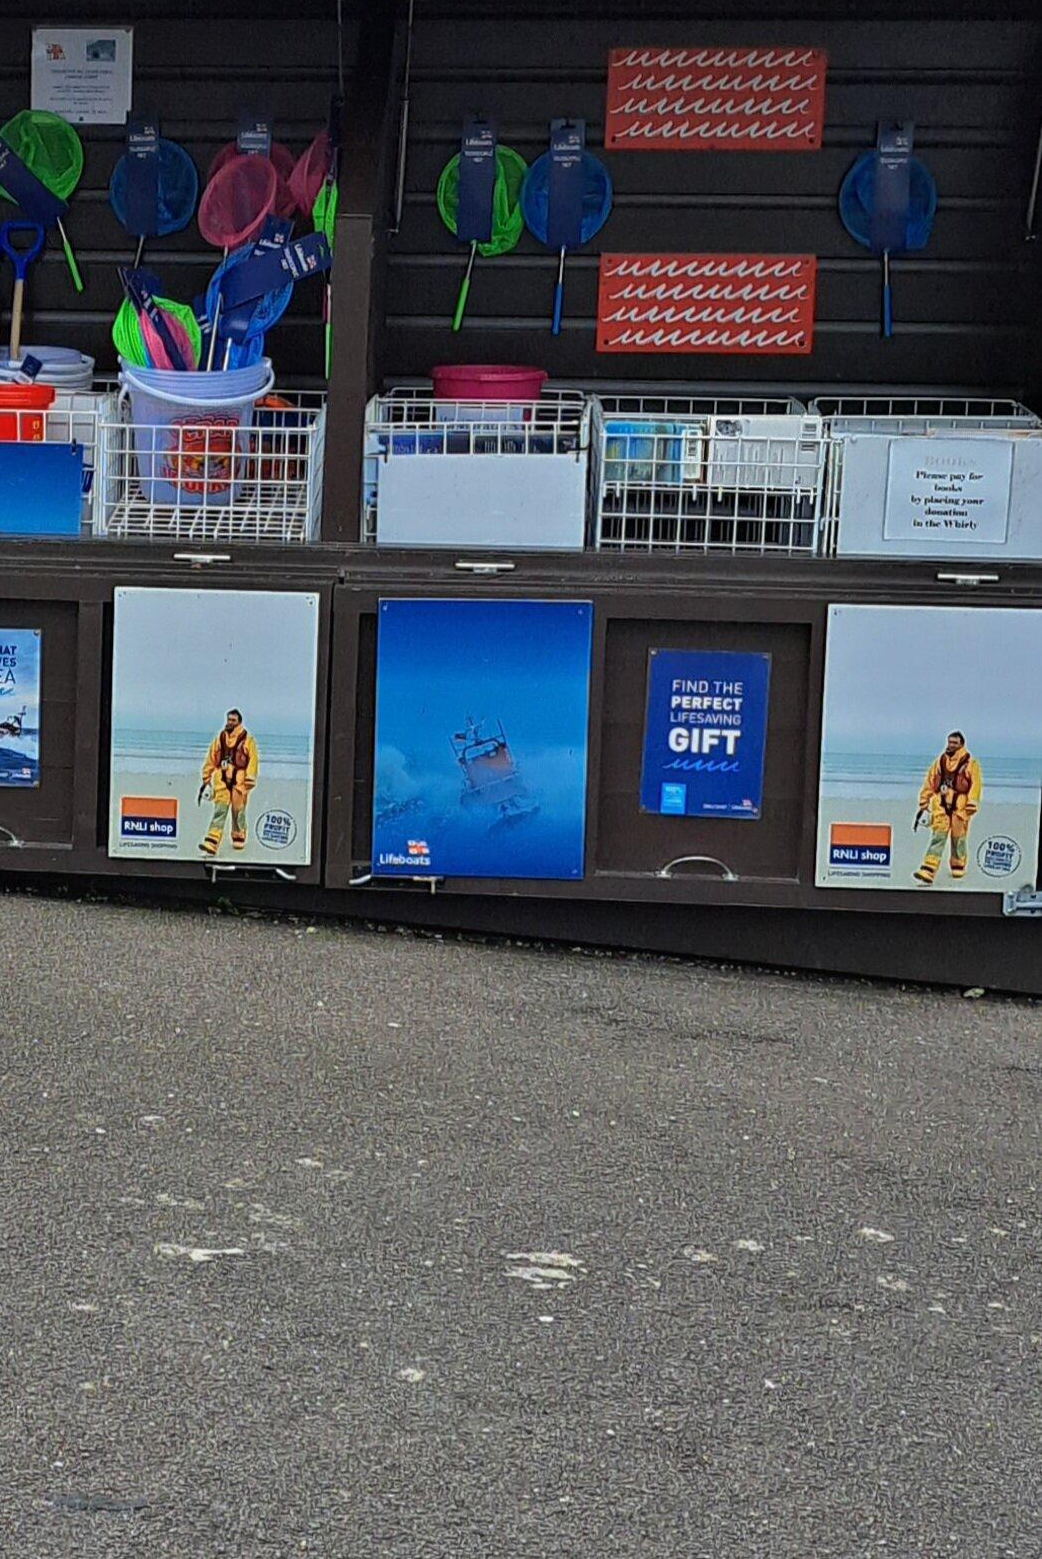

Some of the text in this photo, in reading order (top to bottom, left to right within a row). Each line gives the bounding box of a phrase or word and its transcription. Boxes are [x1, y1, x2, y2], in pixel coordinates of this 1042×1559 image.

[916, 470, 984, 482] Please pay for
[934, 483, 963, 493] books
[924, 496, 960, 506] placing
[961, 498, 984, 507] your
[924, 507, 968, 517] donation
[925, 519, 941, 529] the
[672, 679, 744, 696] FIND THE
[671, 695, 743, 712] PERFECT
[670, 711, 742, 726] LIFESAVING
[668, 726, 741, 755] GIFT
[266, 814, 292, 827] 100%
[124, 820, 174, 835] RNLI shop
[988, 841, 1015, 853] 100%
[379, 853, 431, 866] Lifeboats
[833, 848, 887, 863] RNLI shop
